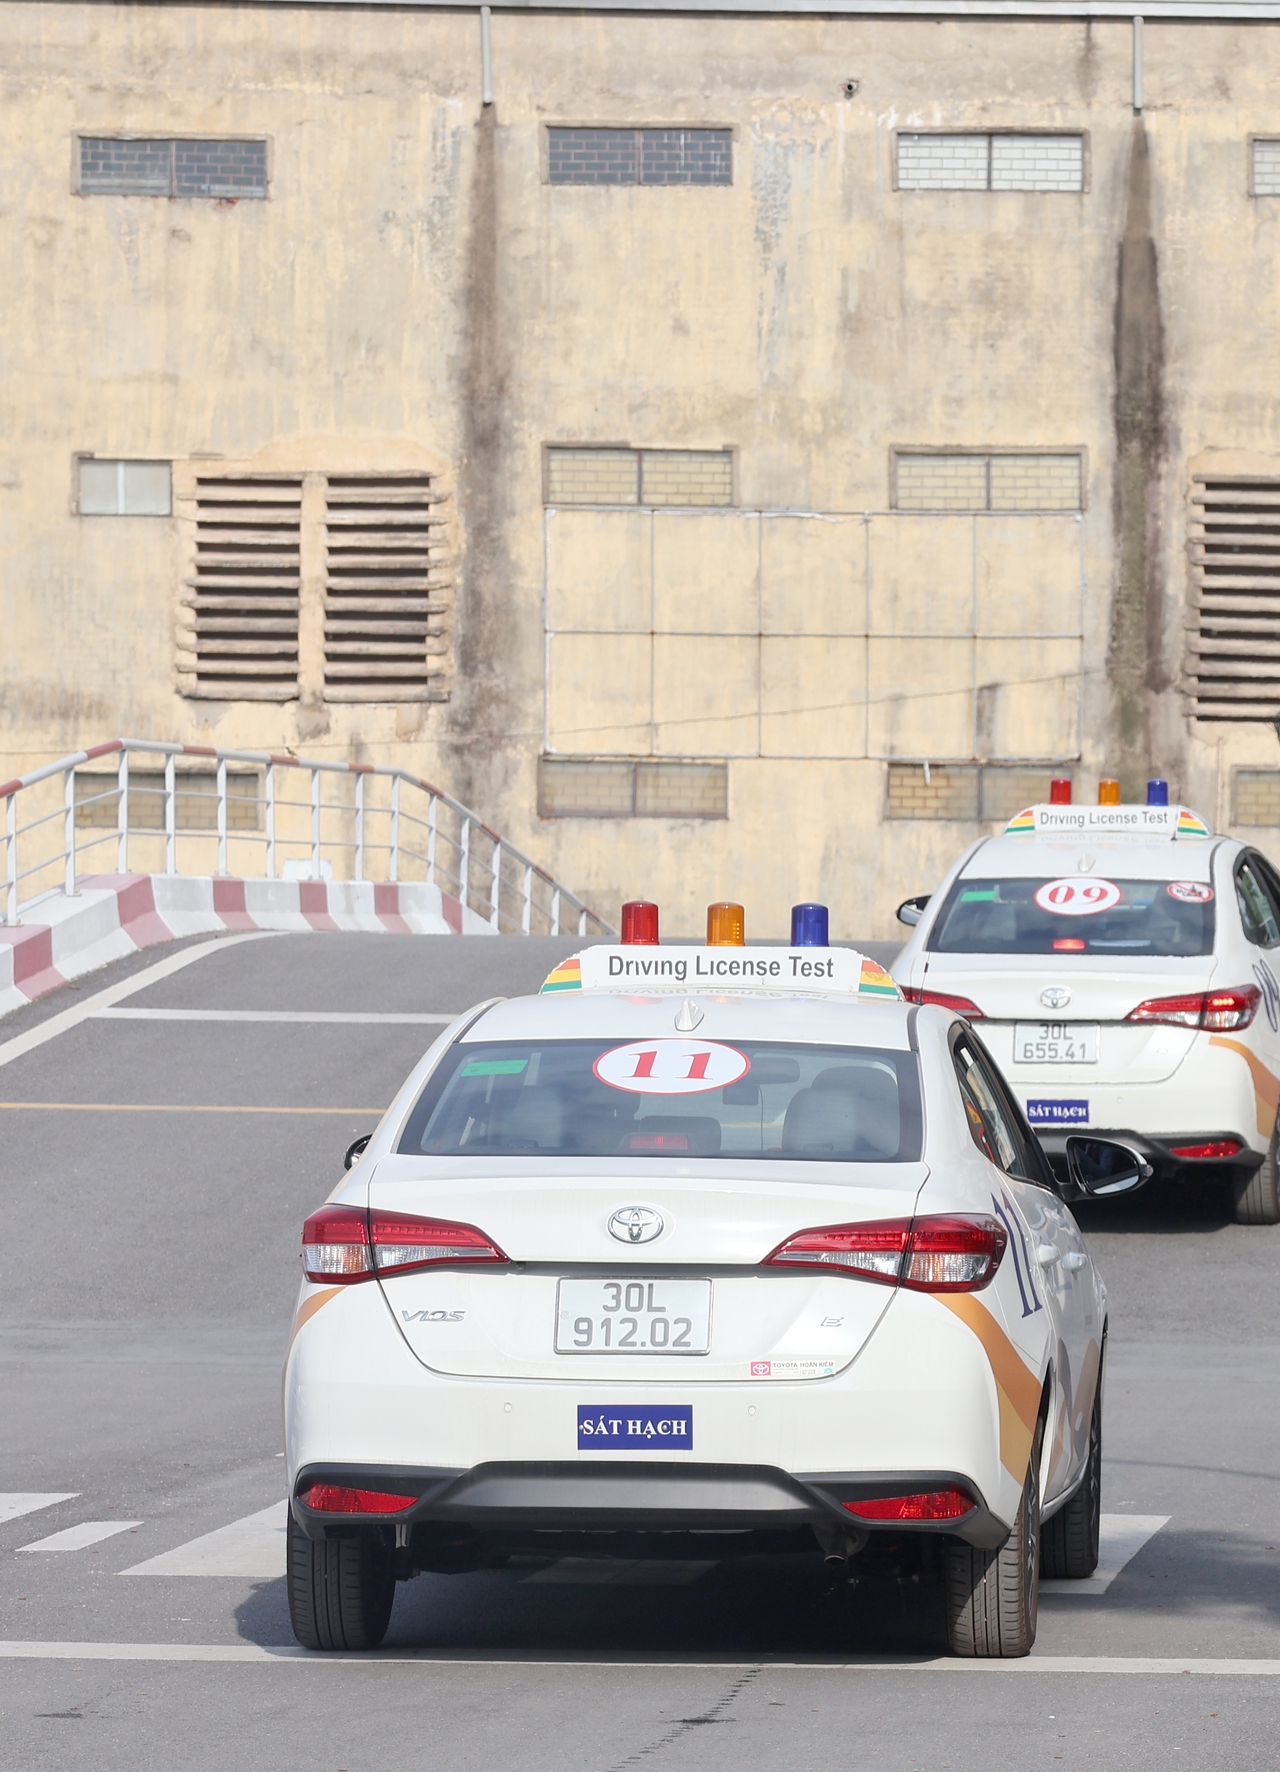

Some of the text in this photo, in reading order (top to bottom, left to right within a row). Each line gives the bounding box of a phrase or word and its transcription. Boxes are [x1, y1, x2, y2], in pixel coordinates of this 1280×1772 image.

[1040, 811, 1168, 829] Driving License Test
[1048, 884, 1109, 905] 09
[608, 955, 834, 981] Driving License Test
[1039, 1023, 1073, 1040] 30L
[1023, 1043, 1087, 1060] 655.41
[621, 1050, 714, 1080] 11
[1029, 1104, 1051, 1117] SÁT
[602, 1283, 667, 1313] 30L
[573, 1317, 692, 1347] 912.02
[583, 1415, 687, 1439] SÁT HẠCH
